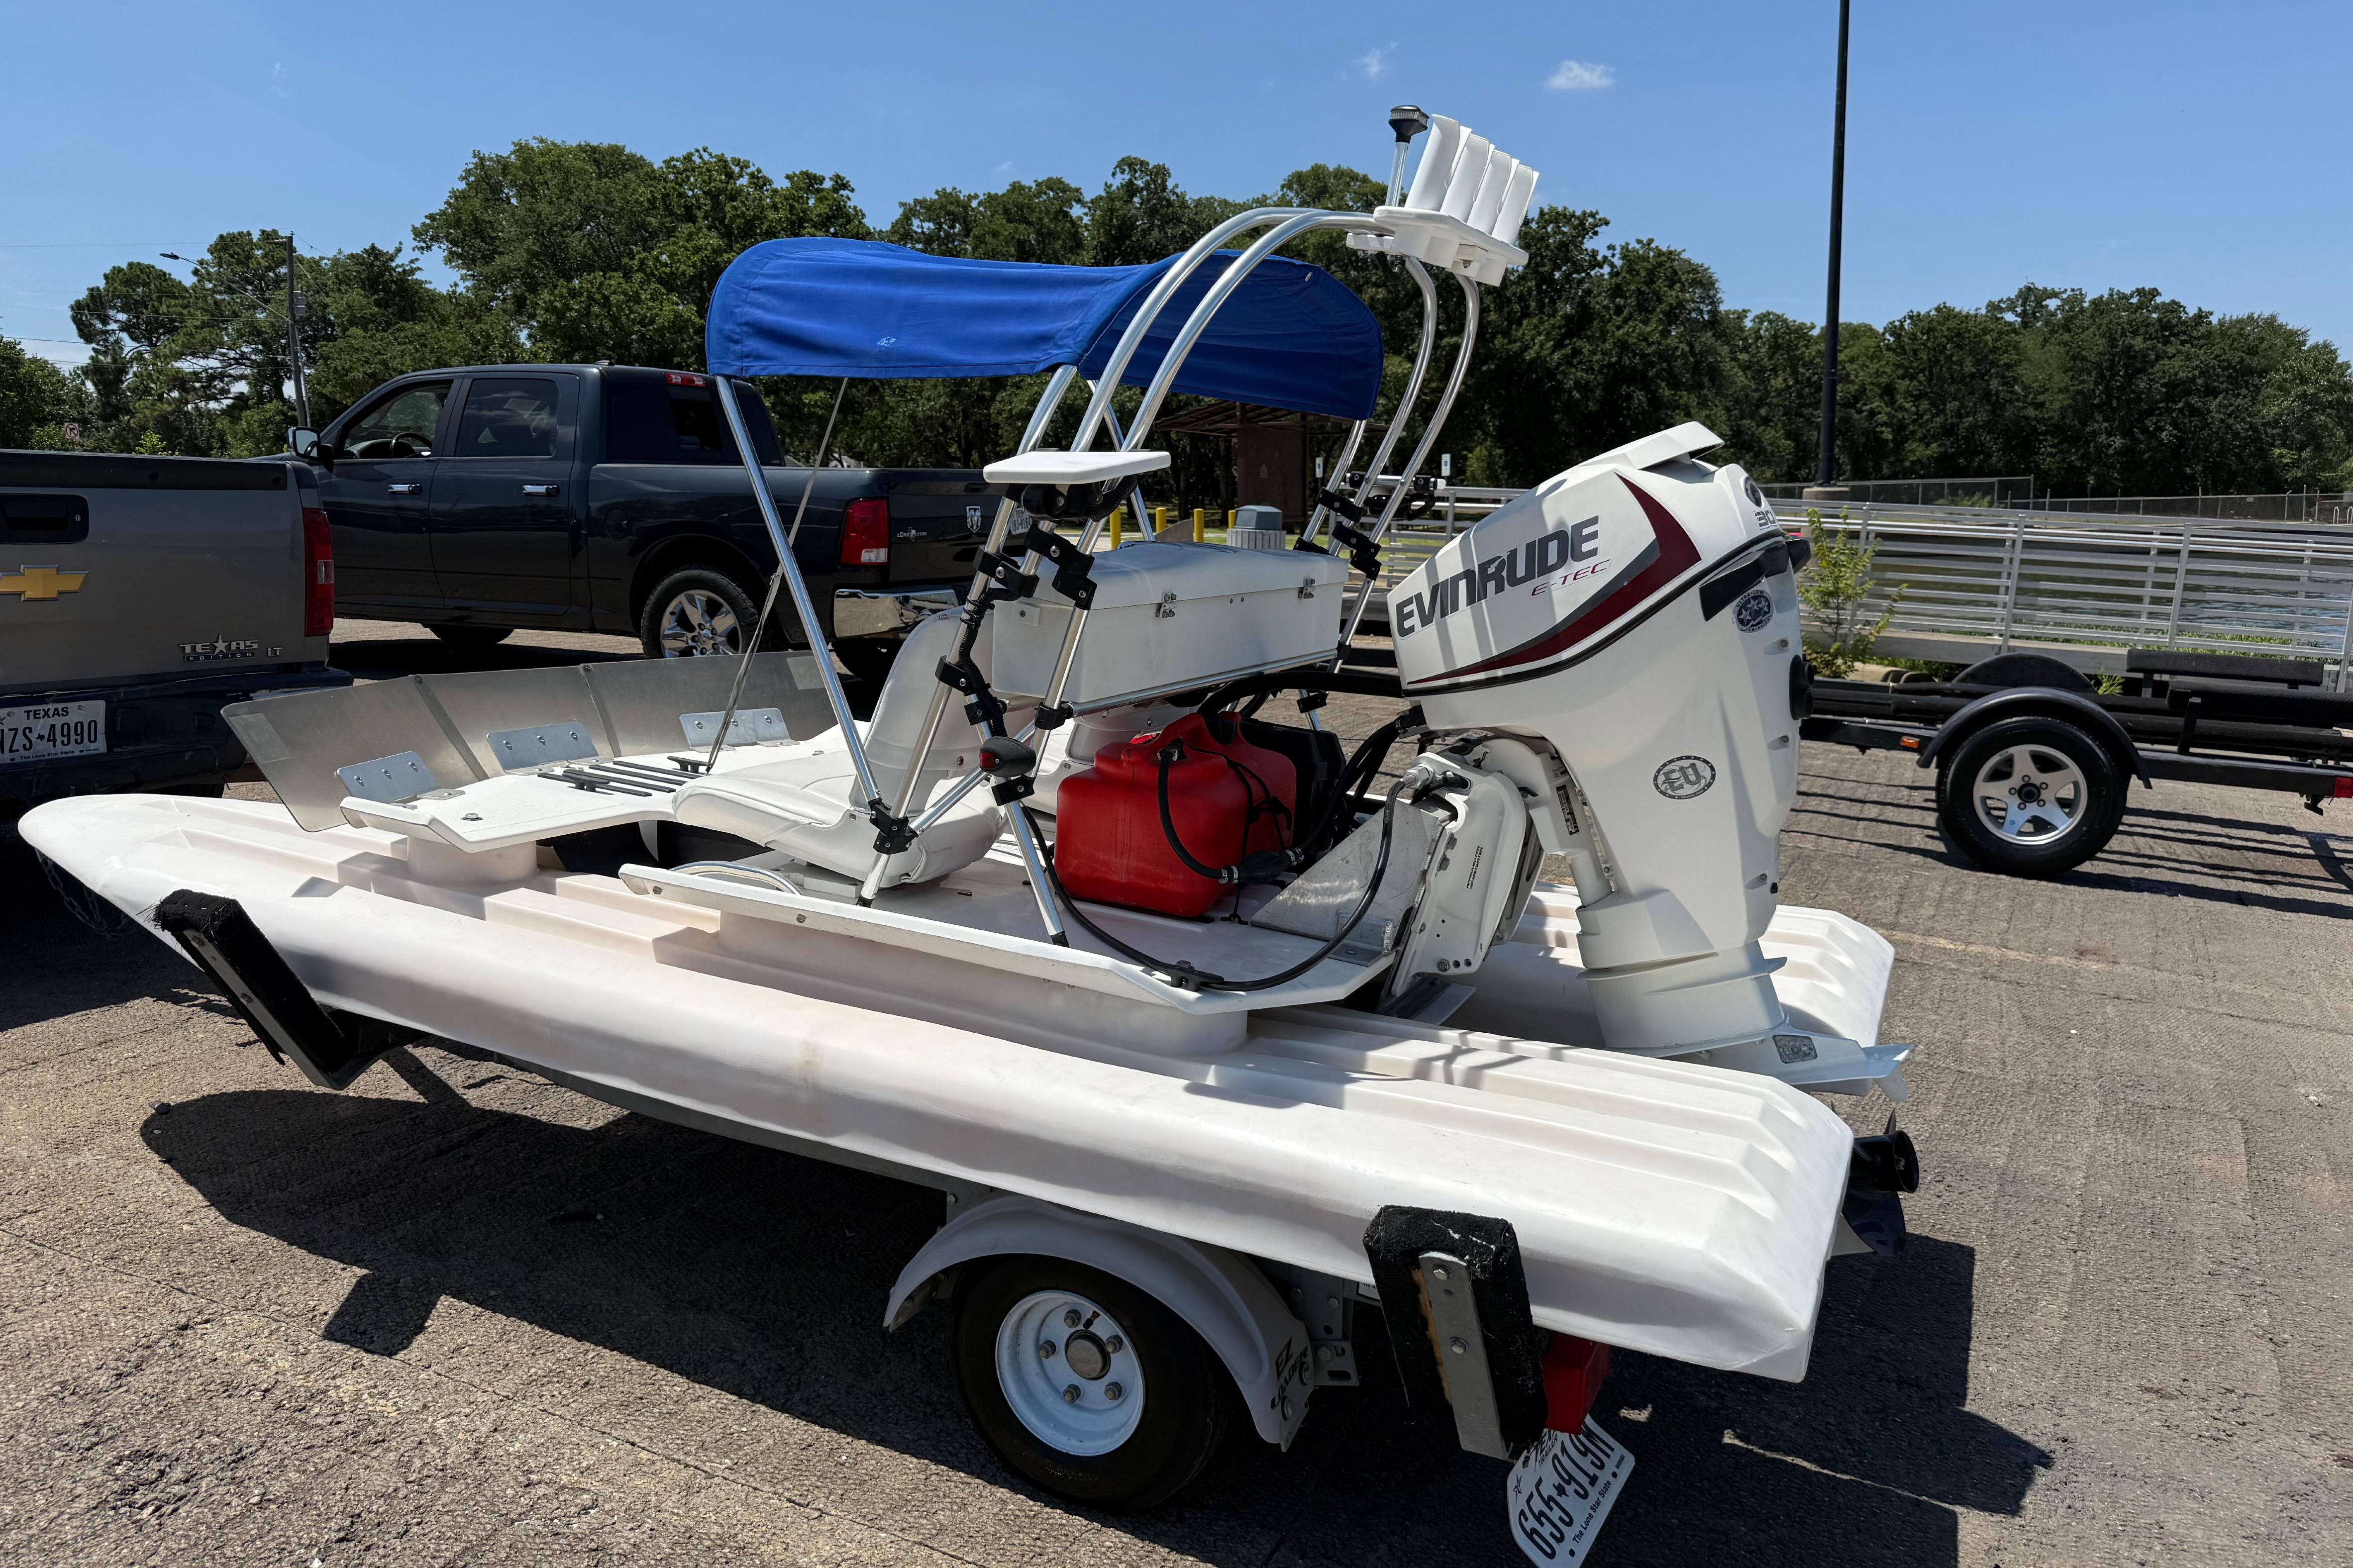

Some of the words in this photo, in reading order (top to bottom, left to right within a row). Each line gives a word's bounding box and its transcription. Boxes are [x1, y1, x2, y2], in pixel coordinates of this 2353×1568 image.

[1396, 515, 1599, 638] EVINRUDE
[1531, 559, 1611, 596] E-TEC
[189, 653, 252, 661] EDITION
[268, 647, 283, 657] LT
[24, 706, 69, 720] TEXAS
[1275, 1337, 1293, 1381] EZ
[1538, 1433, 1558, 1468] TRAILER
[1572, 1530, 1584, 1544] The
[1583, 1512, 1594, 1531] Lone
[1590, 1497, 1601, 1513] Star
[1601, 1479, 1611, 1498] State
